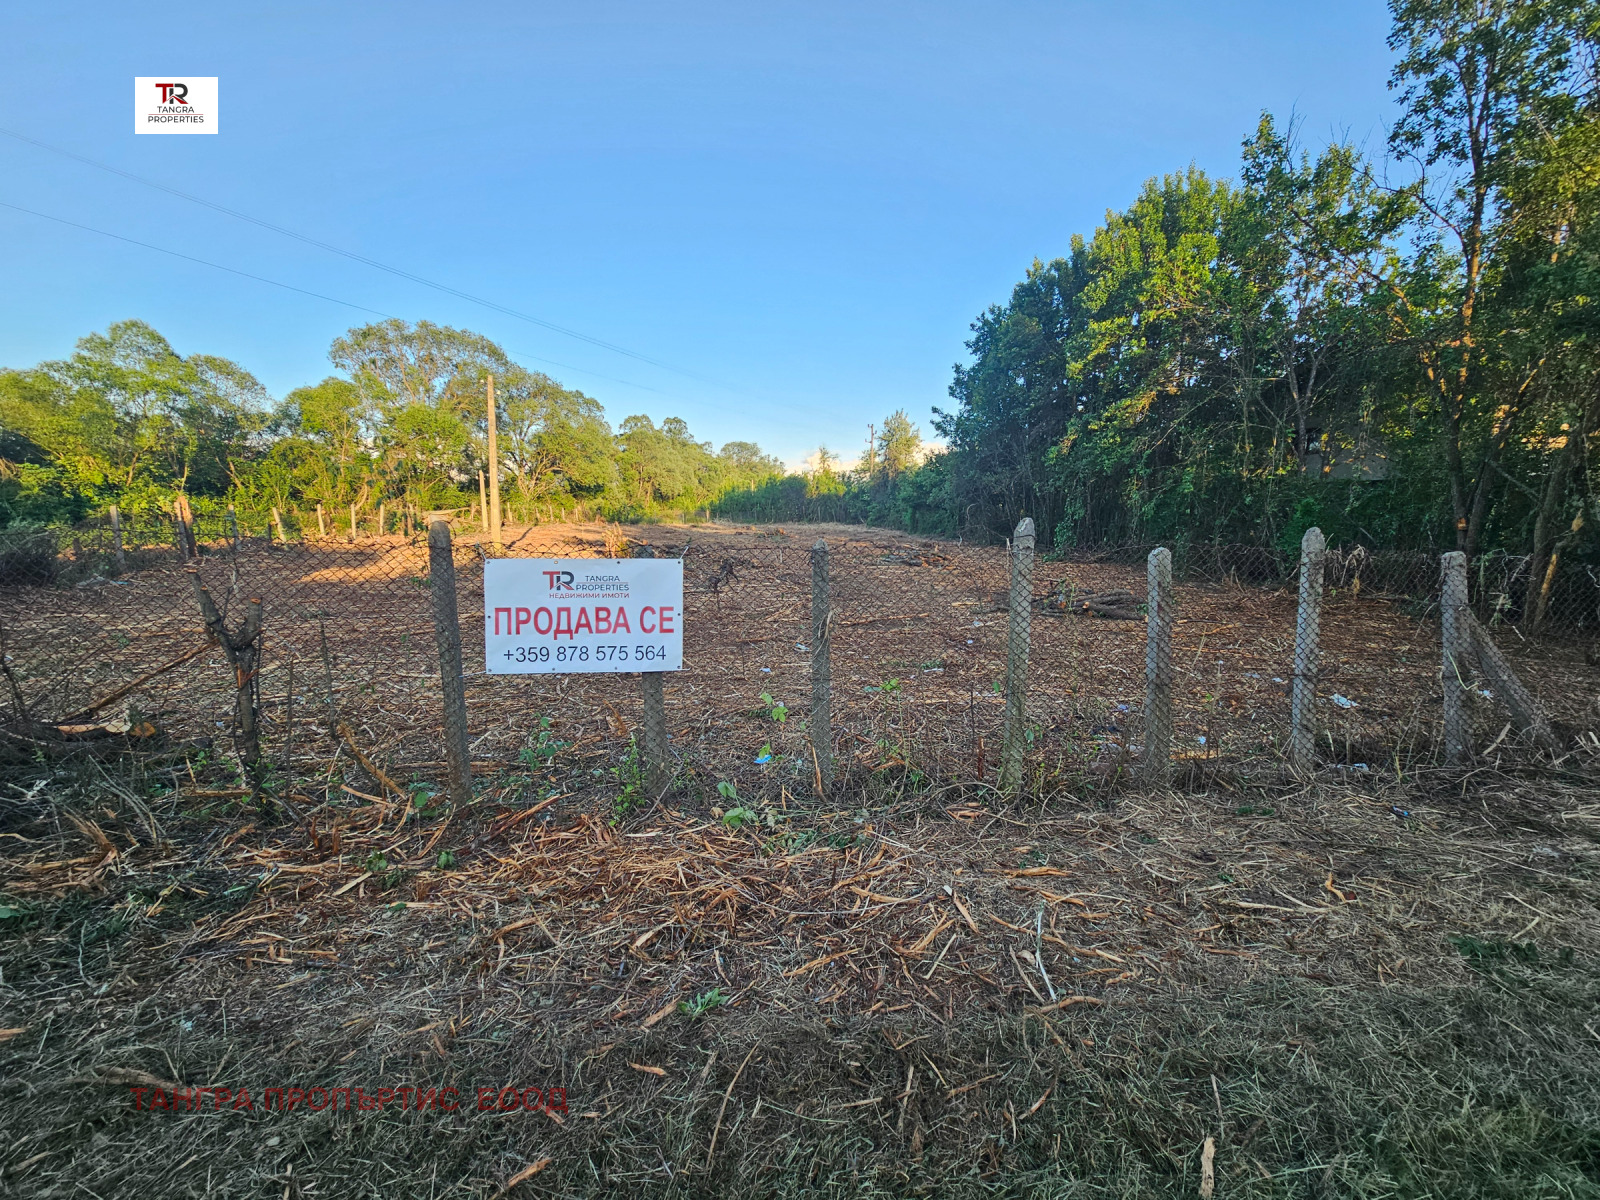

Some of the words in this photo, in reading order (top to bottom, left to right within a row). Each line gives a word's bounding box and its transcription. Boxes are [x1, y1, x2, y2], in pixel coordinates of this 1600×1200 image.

[494, 606, 631, 640] ПРОДАВА
[639, 606, 675, 634] СЕ
[503, 646, 550, 663] +359
[556, 646, 590, 662] 878
[595, 645, 629, 661] 575
[634, 645, 667, 661] 564
